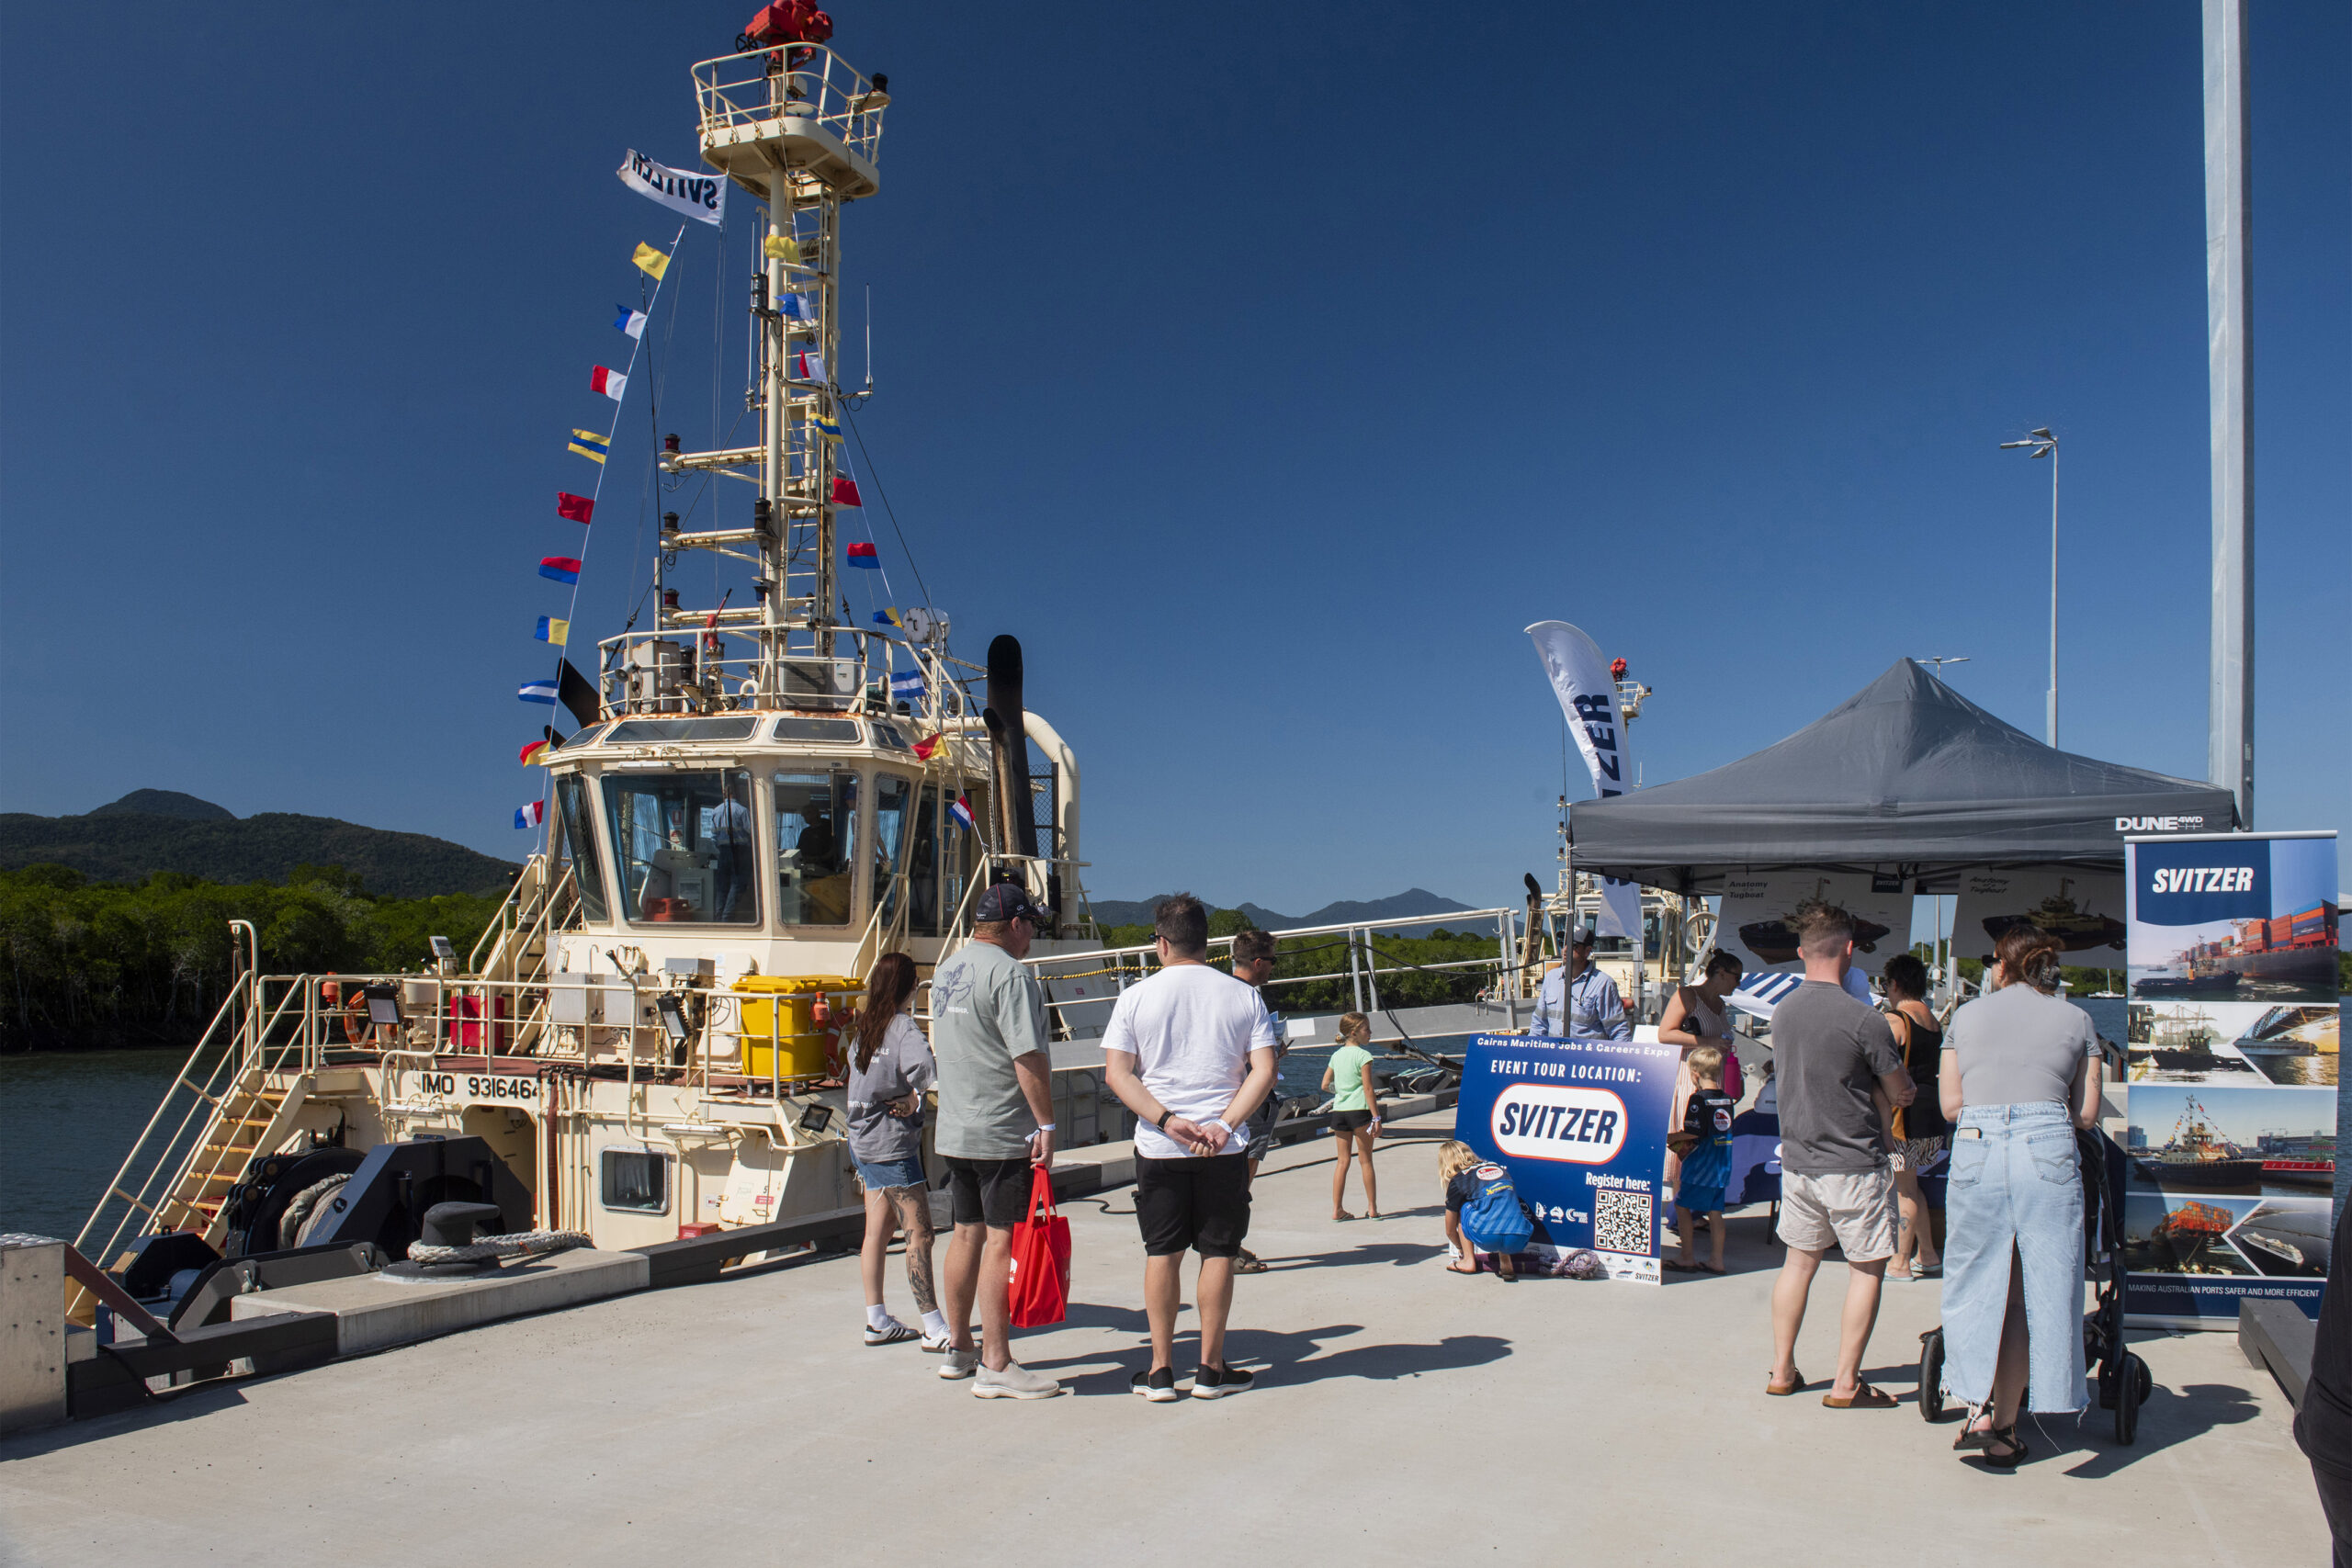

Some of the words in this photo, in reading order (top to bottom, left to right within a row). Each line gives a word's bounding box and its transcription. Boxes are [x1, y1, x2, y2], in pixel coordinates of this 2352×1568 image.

[2115, 817, 2177, 831] DUNE
[2152, 867, 2254, 893] SVITZER
[1477, 1037, 1508, 1046] Cairns
[1510, 1039, 1555, 1049] Maritime
[1558, 1042, 1582, 1051] Jobs
[1585, 1043, 1593, 1052] &
[1596, 1043, 1640, 1055] Careers
[1644, 1047, 1670, 1057] Expo
[1490, 1059, 1528, 1075] EVENT
[1533, 1062, 1566, 1077] TOUR
[1571, 1065, 1642, 1083] LOCATION:
[423, 1073, 454, 1095] IMO
[1499, 1101, 1618, 1145] SVITZER
[1586, 1171, 1624, 1189] Register
[1625, 1176, 1651, 1191] here:
[1634, 1272, 1659, 1282] SVITZER
[2128, 1284, 2156, 1292] MAKING
[2157, 1285, 2200, 1294] AUSTRALIAN
[2201, 1286, 2223, 1295] PORTS
[2224, 1287, 2246, 1295] SAFER
[2247, 1288, 2263, 1296] AND
[2264, 1288, 2285, 1297] MORE
[2286, 1289, 2320, 1298] EFFICIENT
